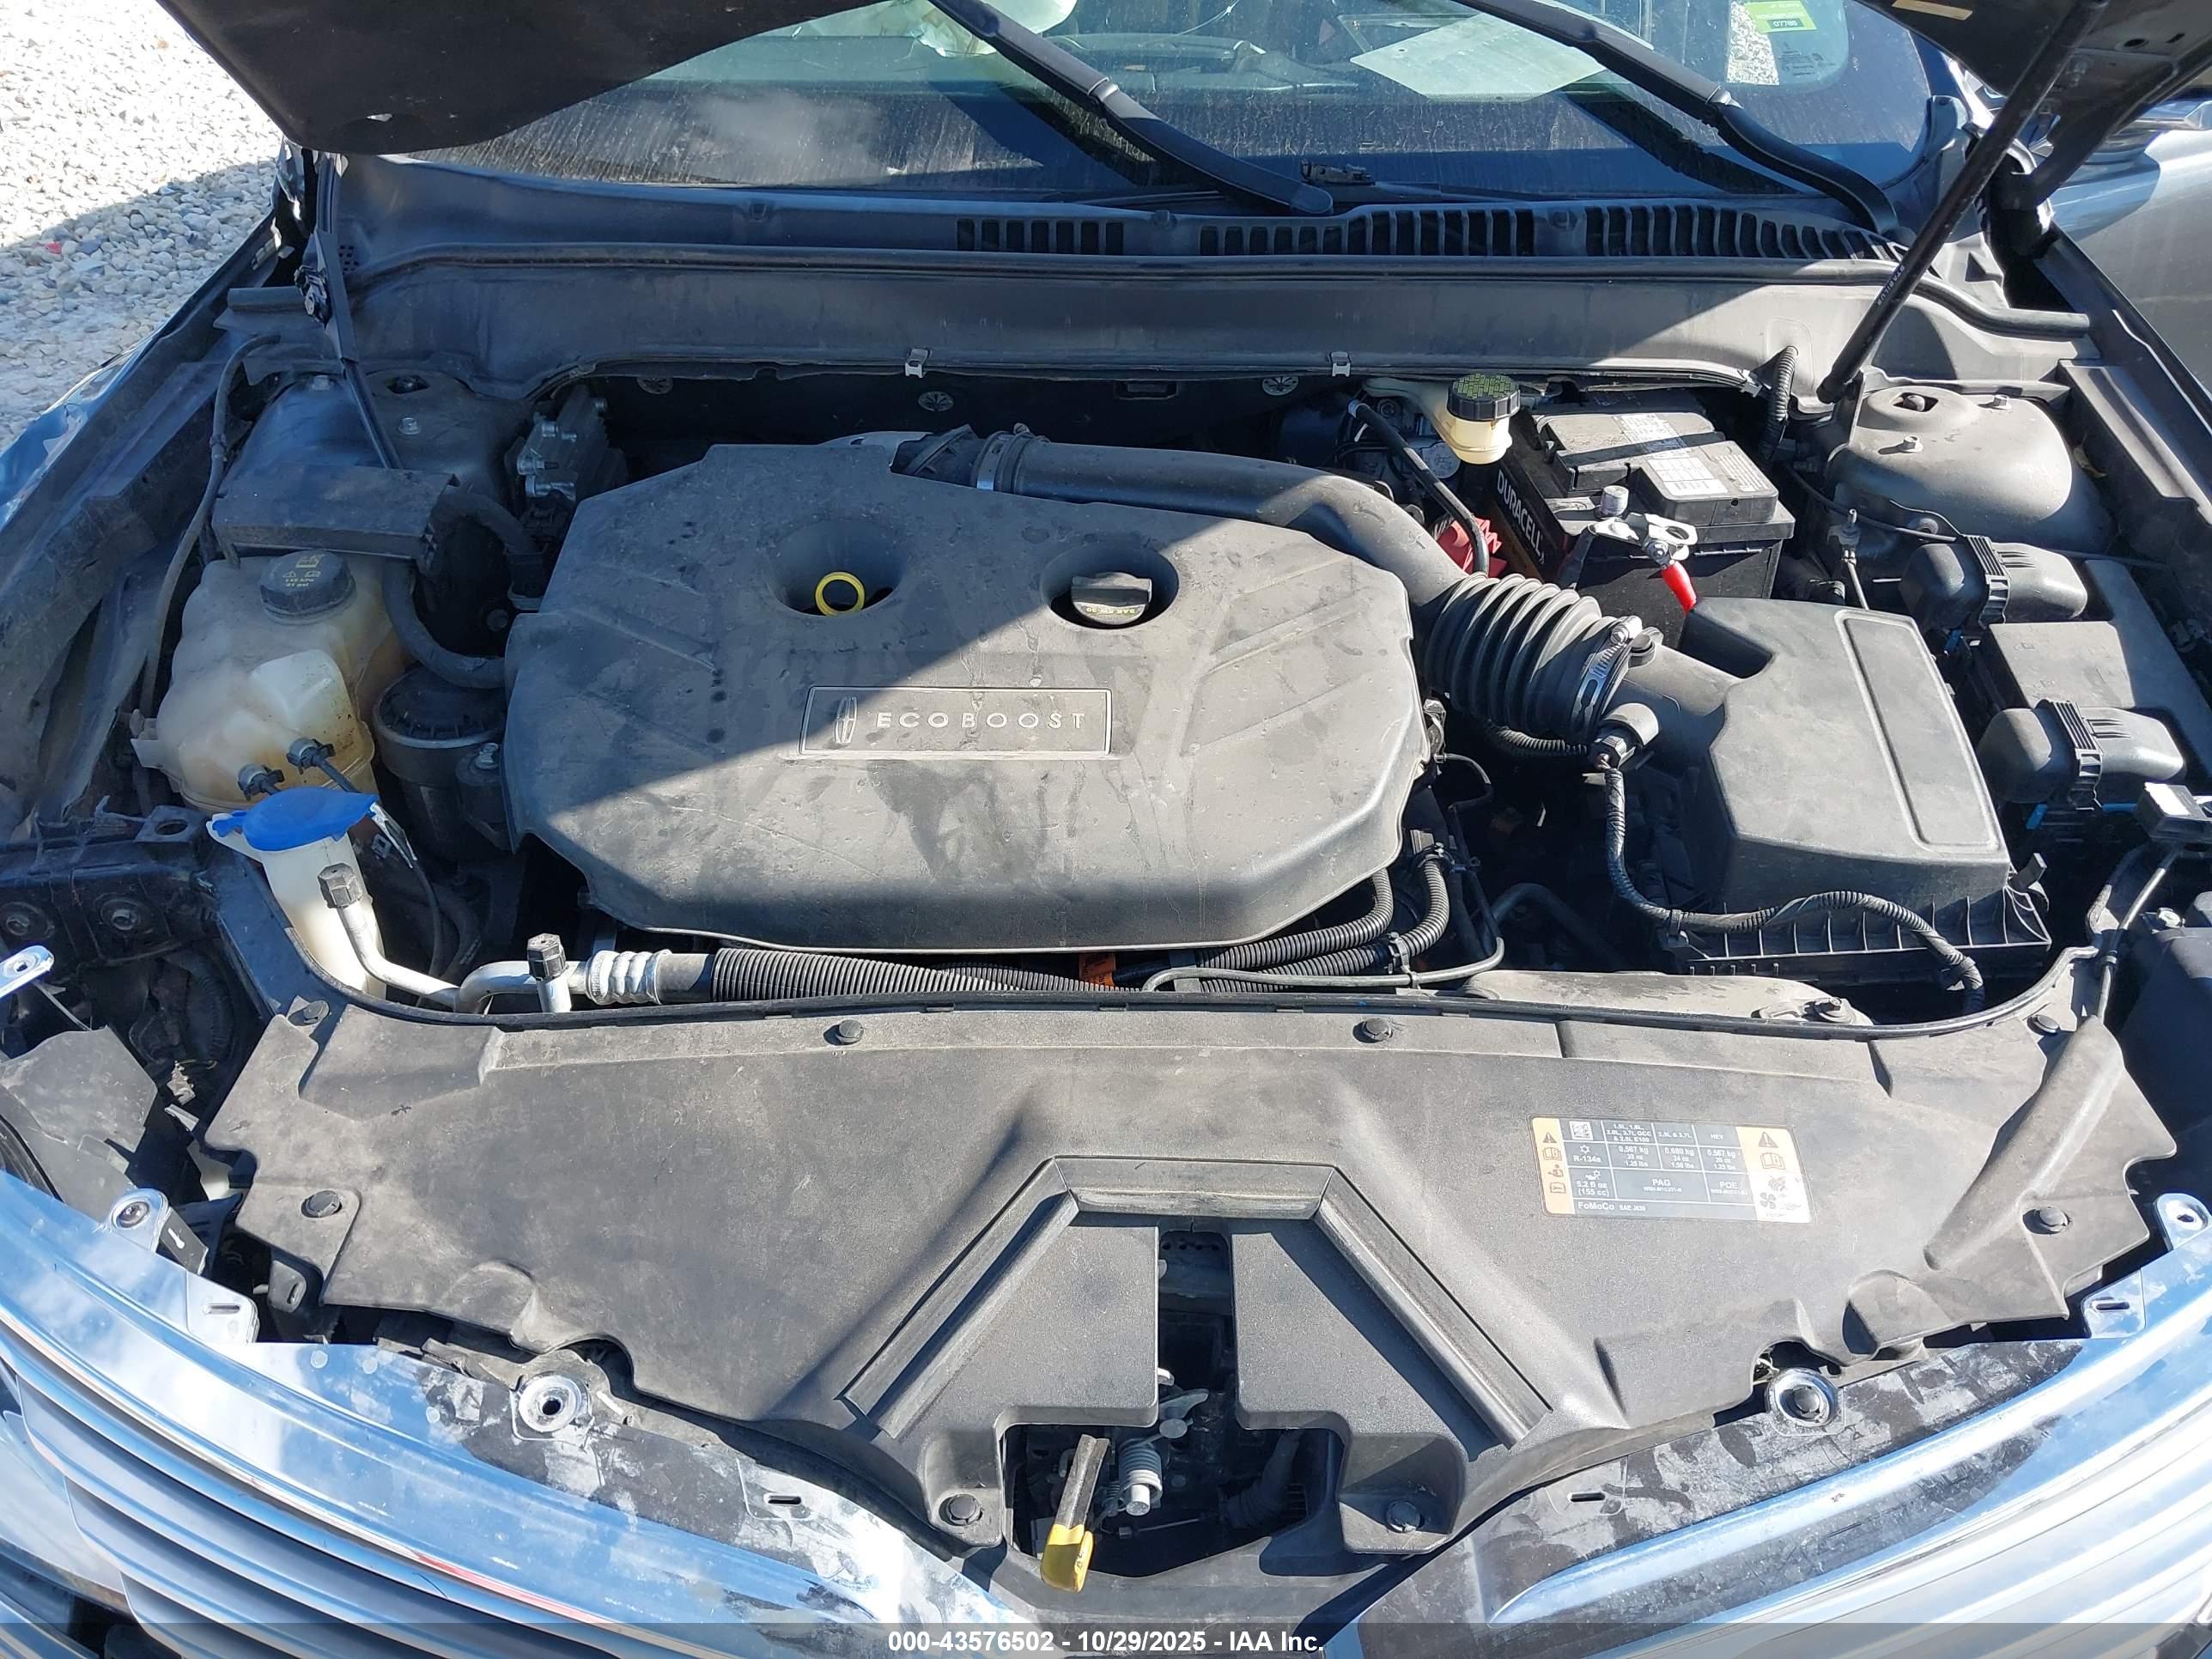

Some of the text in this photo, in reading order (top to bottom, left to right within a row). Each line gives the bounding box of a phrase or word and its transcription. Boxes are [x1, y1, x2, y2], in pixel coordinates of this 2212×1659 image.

[1877, 264, 1905, 306] STABILUS
[1497, 469, 1540, 556] DURACELL
[875, 712, 1085, 729] ECOBOOST
[1639, 1146, 1649, 1155] kg
[1685, 1147, 1695, 1157] kg
[1726, 1150, 1736, 1158] kg
[1651, 1178, 1671, 1187] PAG
[1578, 1188, 1609, 1197] (155 cc)
[1577, 1201, 1615, 1210] FoMoCo
